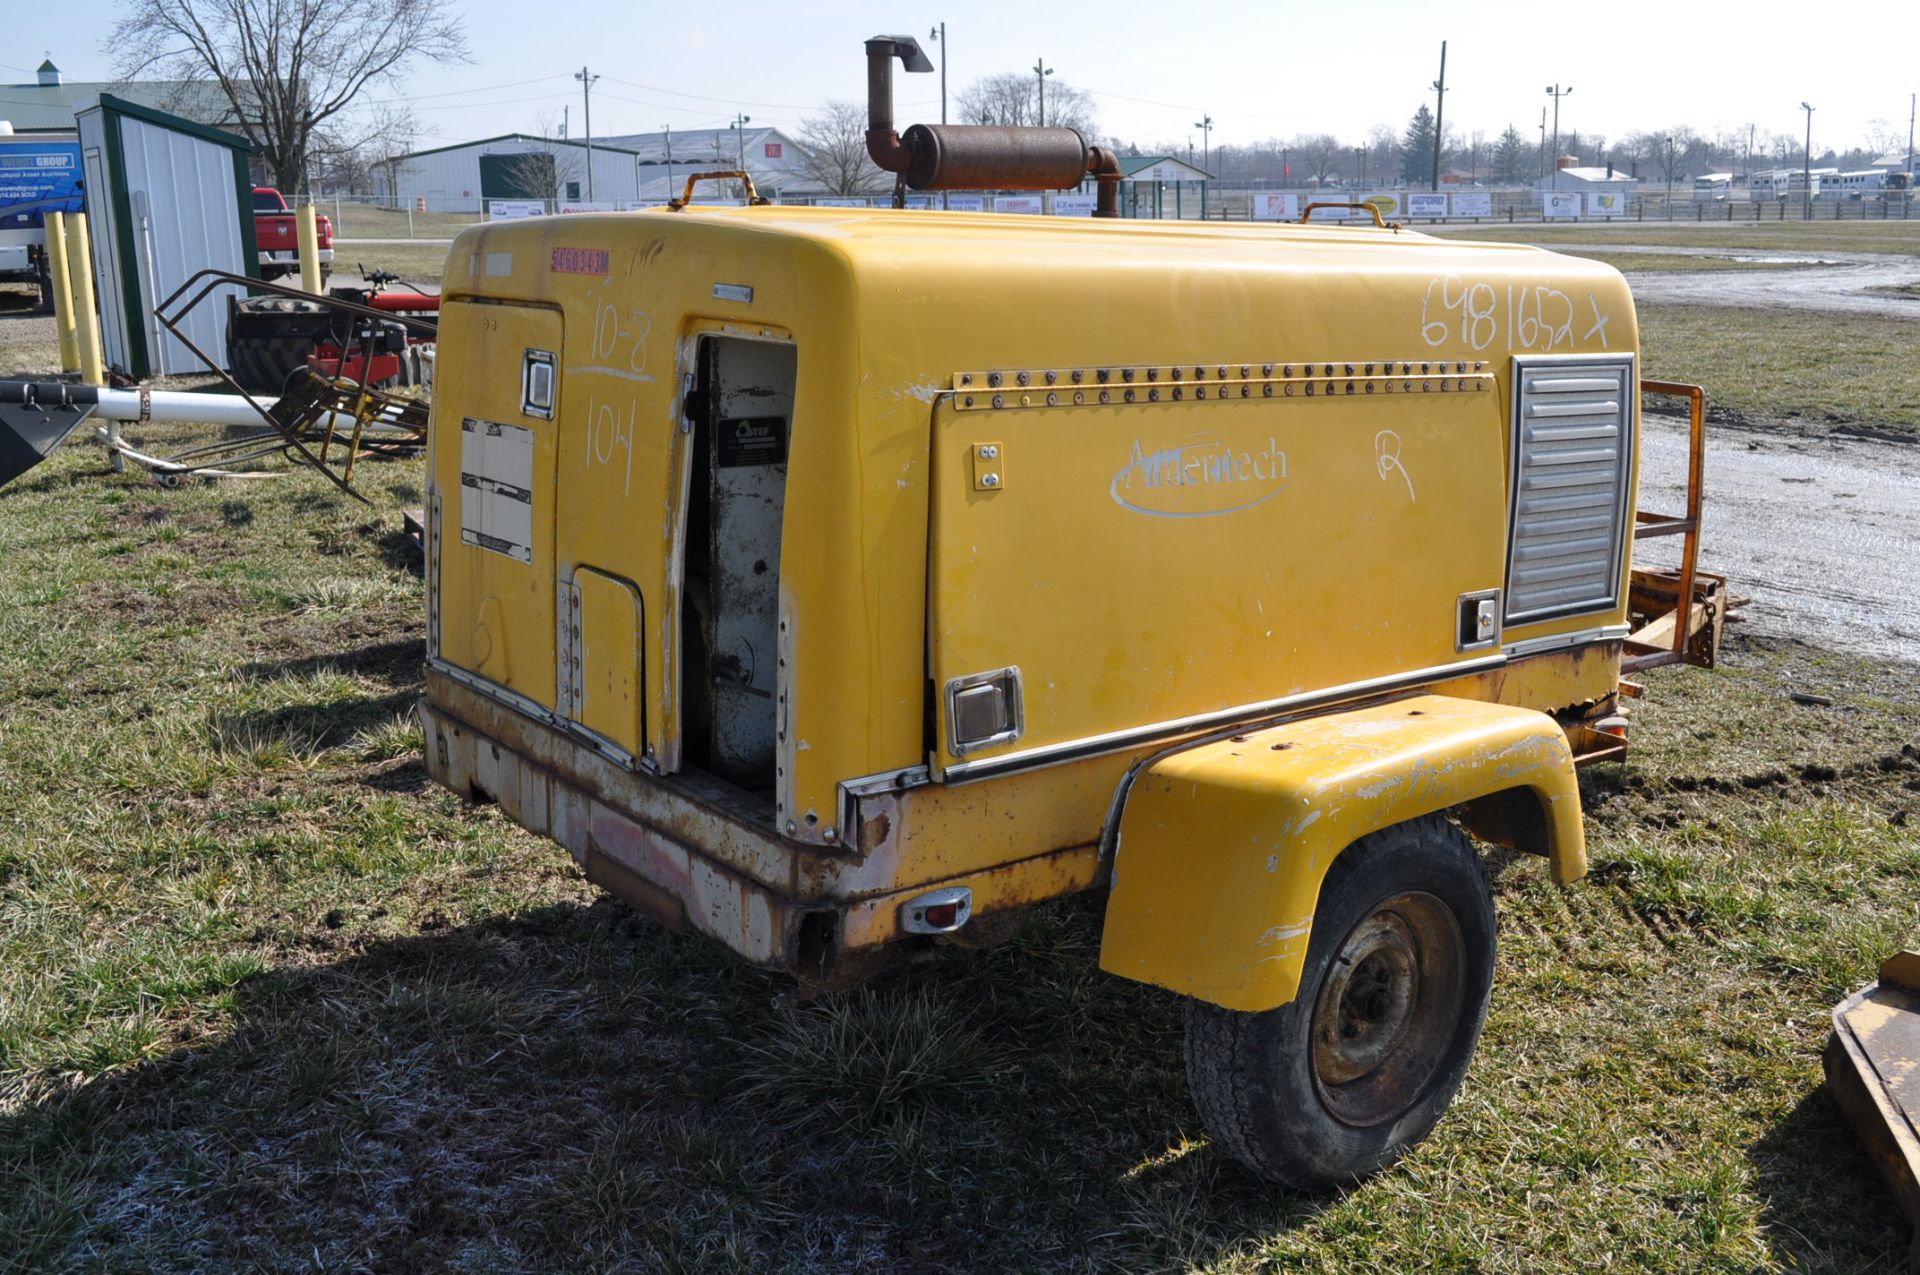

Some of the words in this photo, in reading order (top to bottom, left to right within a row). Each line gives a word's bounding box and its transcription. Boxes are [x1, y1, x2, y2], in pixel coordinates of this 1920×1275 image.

[36, 156, 68, 167] GROUP
[586, 395, 637, 497] 104
[1124, 436, 1288, 489] Ameritech
